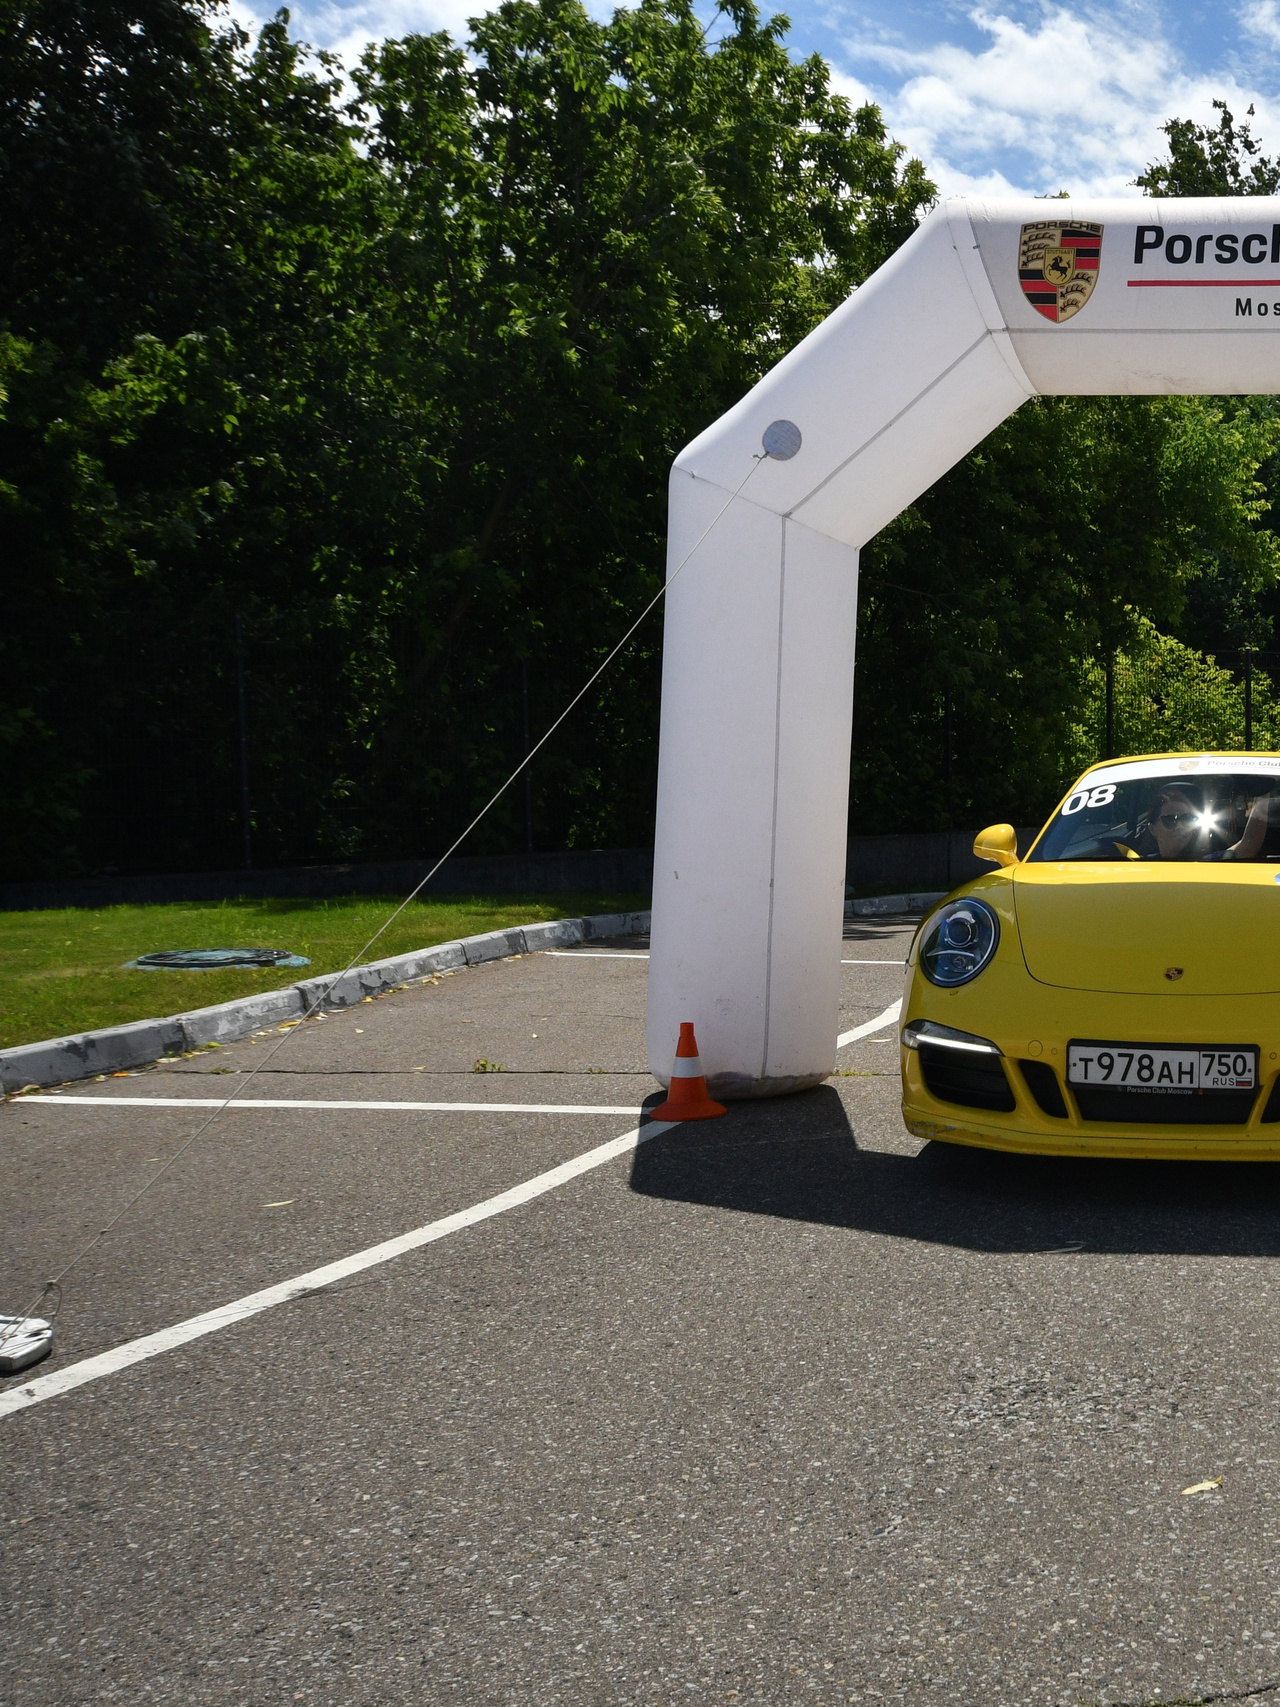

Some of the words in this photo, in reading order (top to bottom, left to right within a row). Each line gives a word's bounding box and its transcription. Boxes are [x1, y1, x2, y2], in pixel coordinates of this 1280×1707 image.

[1023, 221, 1102, 233] PORSCHE
[1061, 784, 1118, 816] 08
[1202, 1053, 1247, 1077] 750
[1212, 1077, 1236, 1086] RUS
[1127, 1086, 1151, 1094] Porsche
[1152, 1086, 1167, 1094] Club
